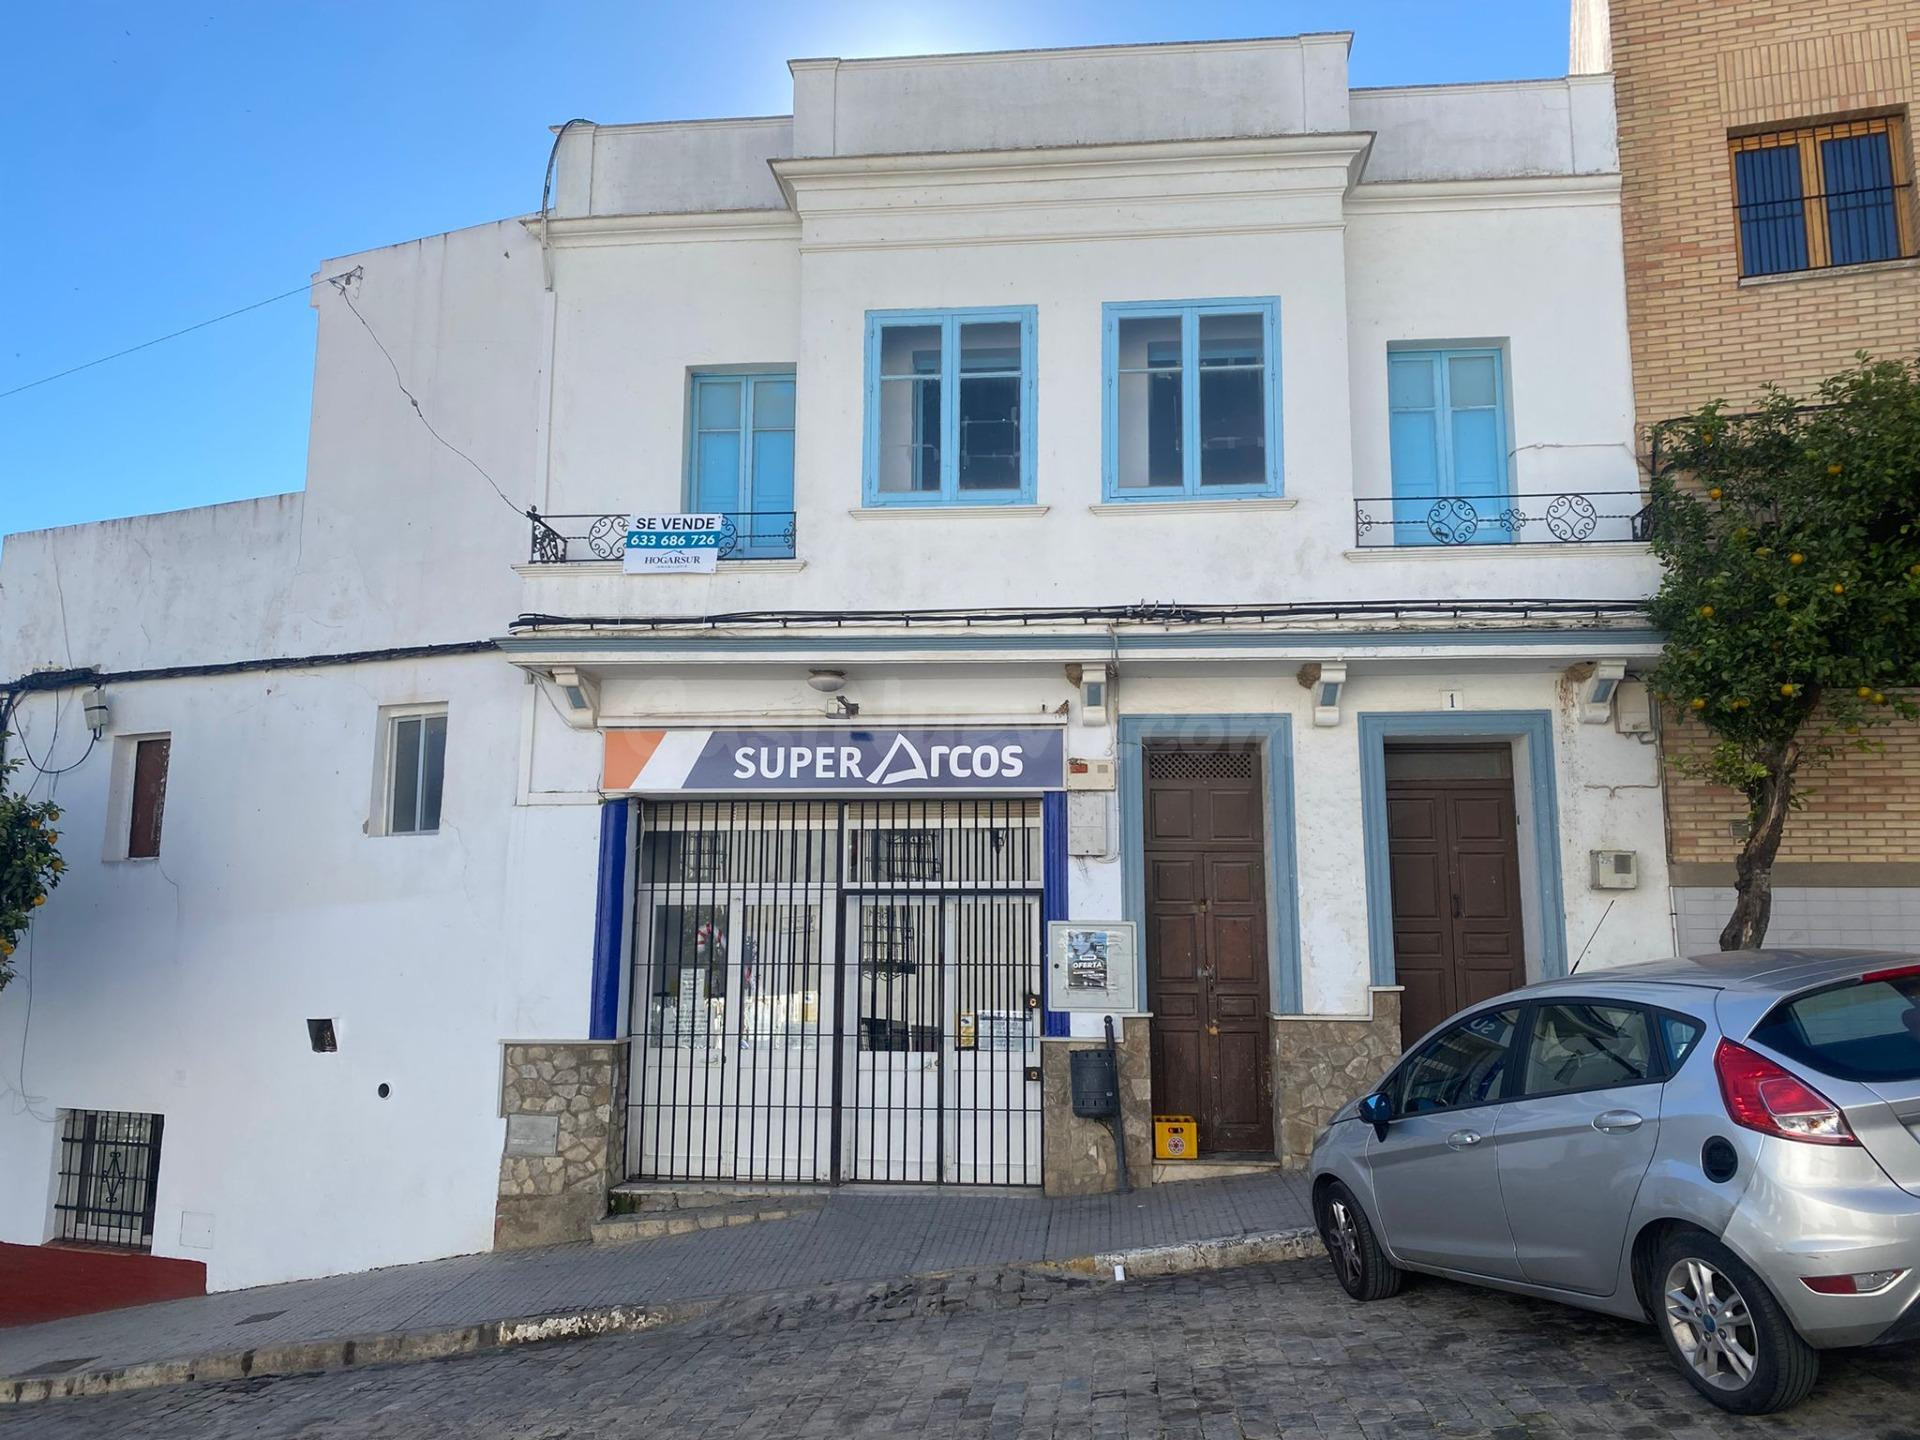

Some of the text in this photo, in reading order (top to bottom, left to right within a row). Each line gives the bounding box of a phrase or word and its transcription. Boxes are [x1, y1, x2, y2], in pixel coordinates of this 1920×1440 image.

[636, 517, 715, 530] SE VENDE
[630, 534, 715, 546] 633 686 726
[644, 555, 701, 565] HOGARSUR
[1449, 693, 1455, 708] 1
[733, 745, 864, 780] SUPER
[1073, 961, 1102, 969] OFERTA
